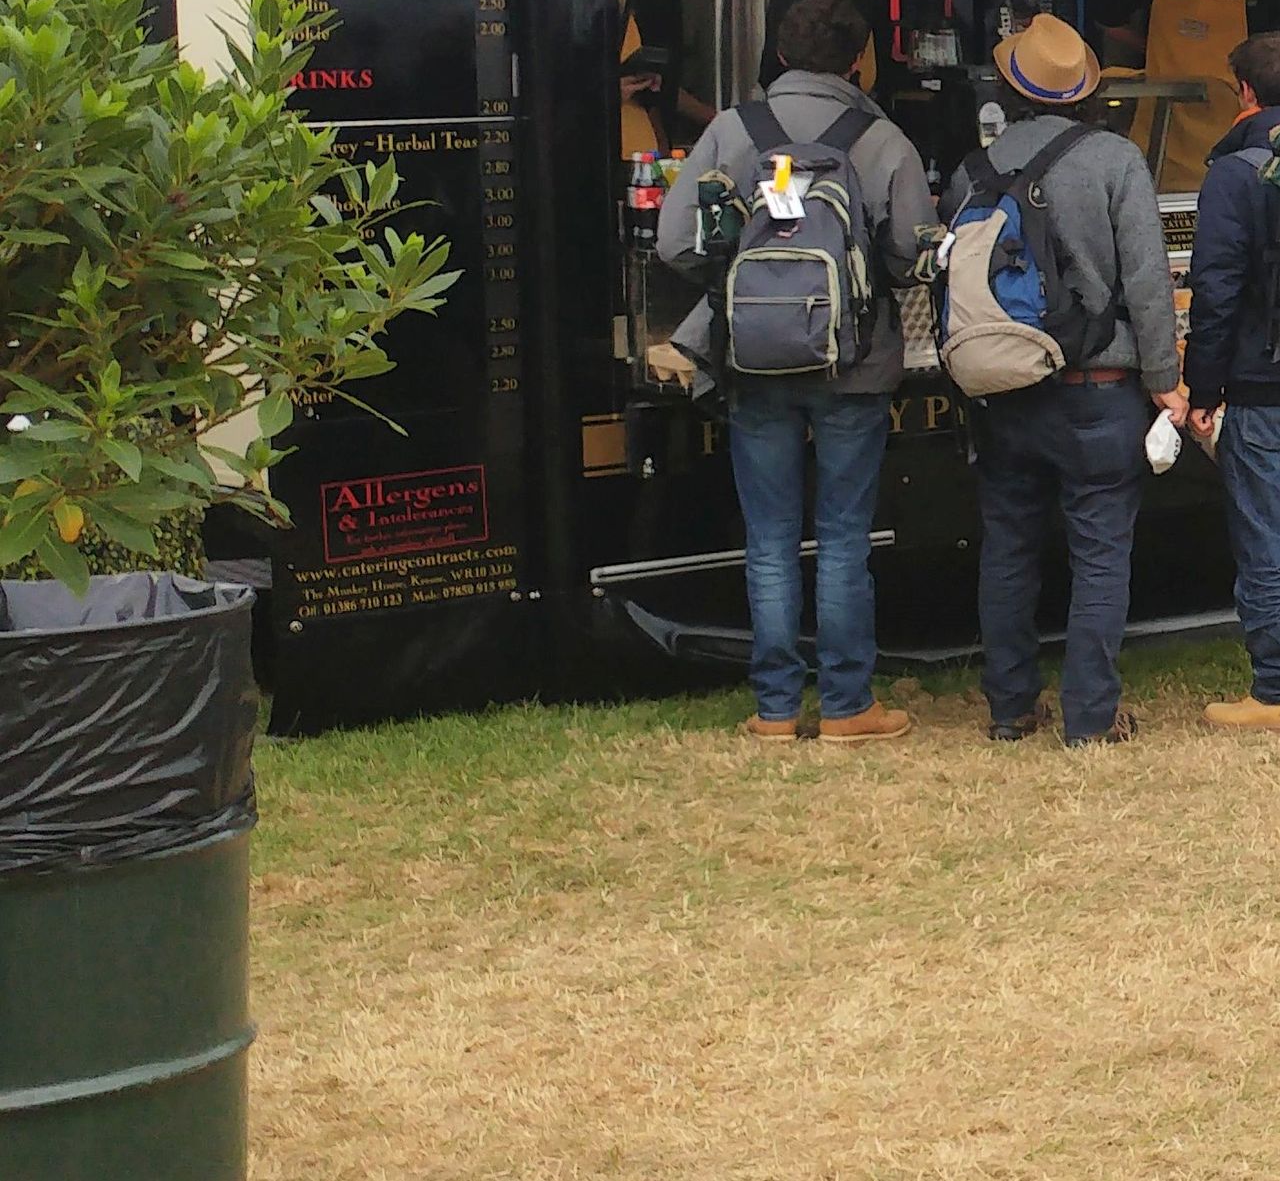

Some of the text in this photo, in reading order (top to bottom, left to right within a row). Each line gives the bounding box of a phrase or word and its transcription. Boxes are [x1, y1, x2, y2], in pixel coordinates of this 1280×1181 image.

[290, 70, 375, 90] RINKS
[441, 131, 479, 150] Teas
[328, 480, 480, 513] Allergens
[339, 515, 358, 532] &
[295, 545, 518, 584] www.cateringcontracts.com
